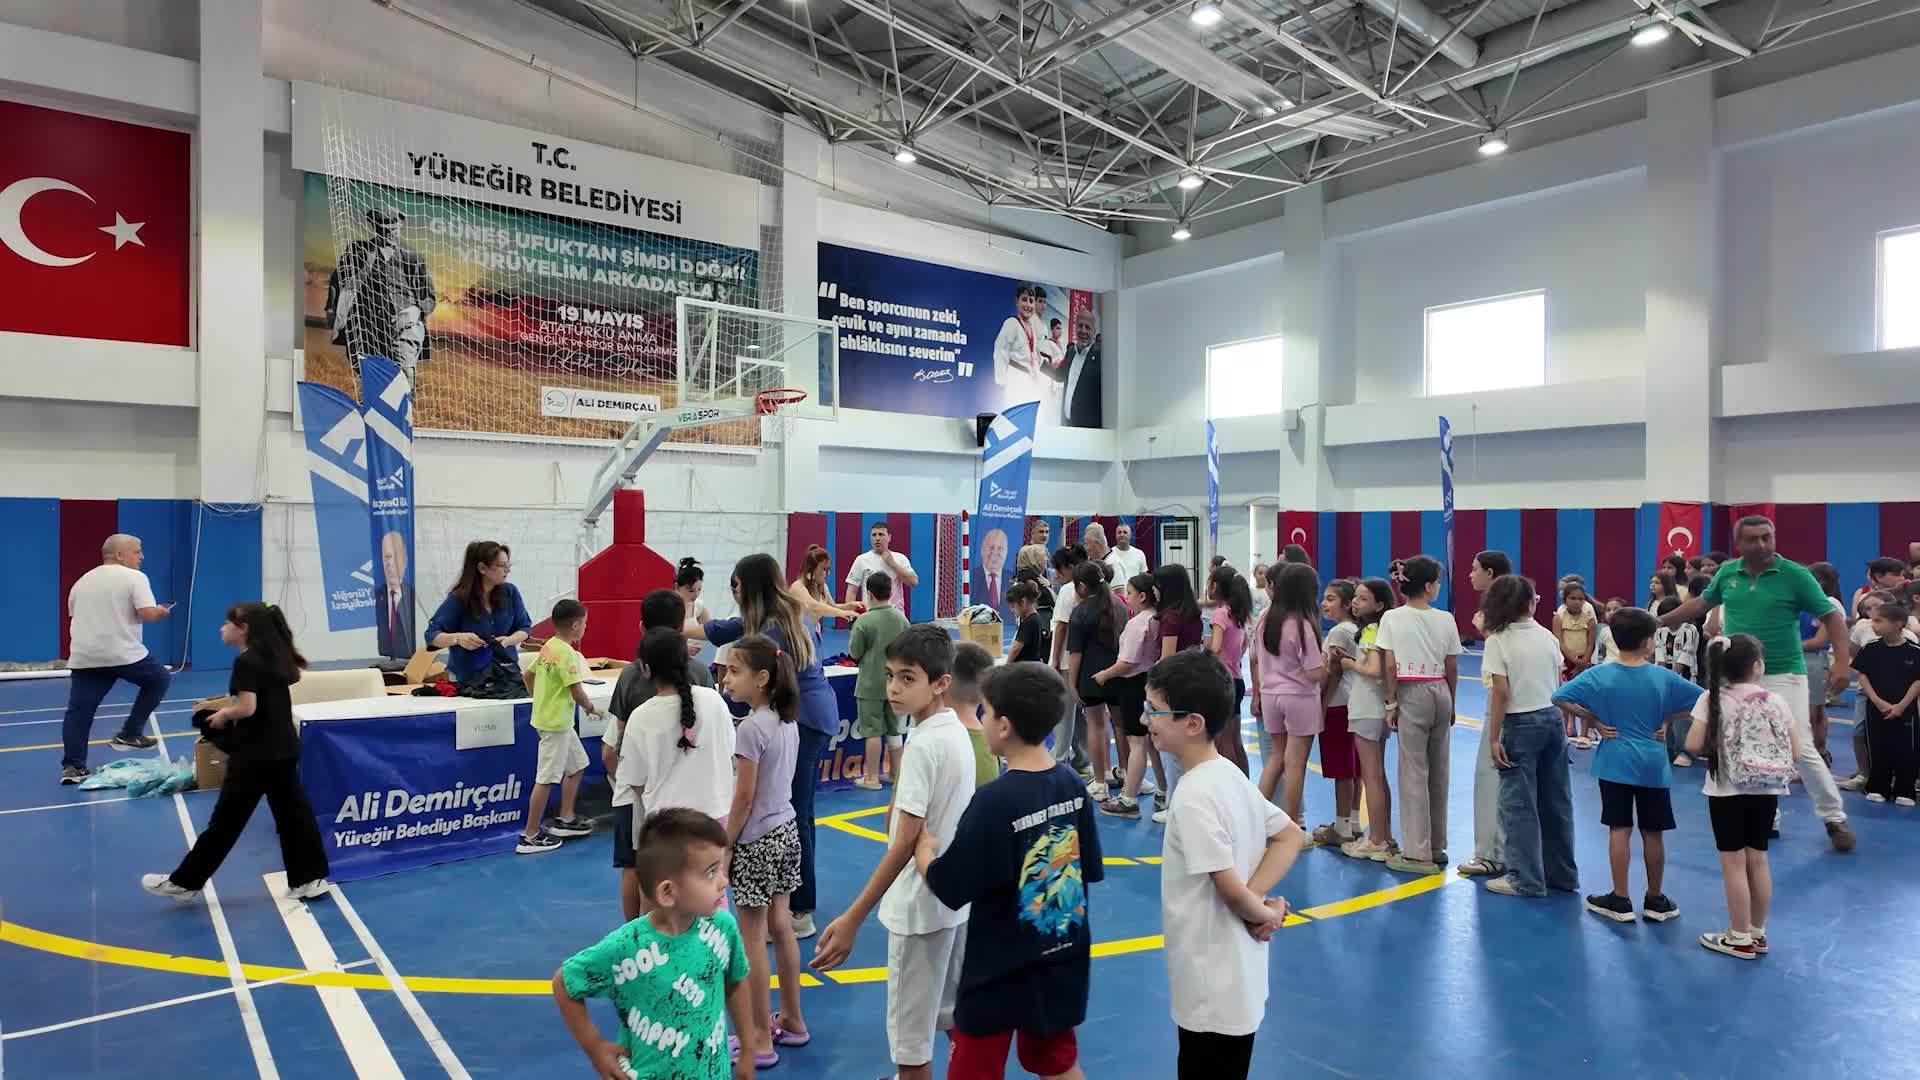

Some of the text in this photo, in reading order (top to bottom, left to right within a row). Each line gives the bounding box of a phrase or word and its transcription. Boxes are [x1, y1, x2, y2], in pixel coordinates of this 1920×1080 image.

[531, 141, 577, 171] T.C.
[407, 151, 682, 225] YÜREĞİR BELEDİYESİ
[429, 217, 746, 281] GÜNEŞ UFUKTAN ŞİMDİ DOĞAR
[456, 246, 588, 281] YÜRÜYELİM
[558, 305, 644, 329] 19 MAYIS
[840, 292, 961, 327] Ben sporcunun zeki,
[520, 331, 569, 347] GENÇLİK
[585, 339, 614, 350] SPOR
[617, 343, 678, 357] BAYRAMIMIZ
[618, 330, 658, 344] ANMA
[840, 333, 907, 357] ahlâklısını
[868, 321, 884, 333] ve
[885, 323, 912, 338] aynı
[914, 326, 967, 345] zamanda
[575, 397, 657, 412] ALİ DEMİRÇALI
[334, 773, 522, 823] Ali Demirçalı
[333, 809, 521, 848] Yüreğir Belediye Başkanı
[611, 941, 669, 985] COOL
[627, 1006, 690, 1058] HAPPY
